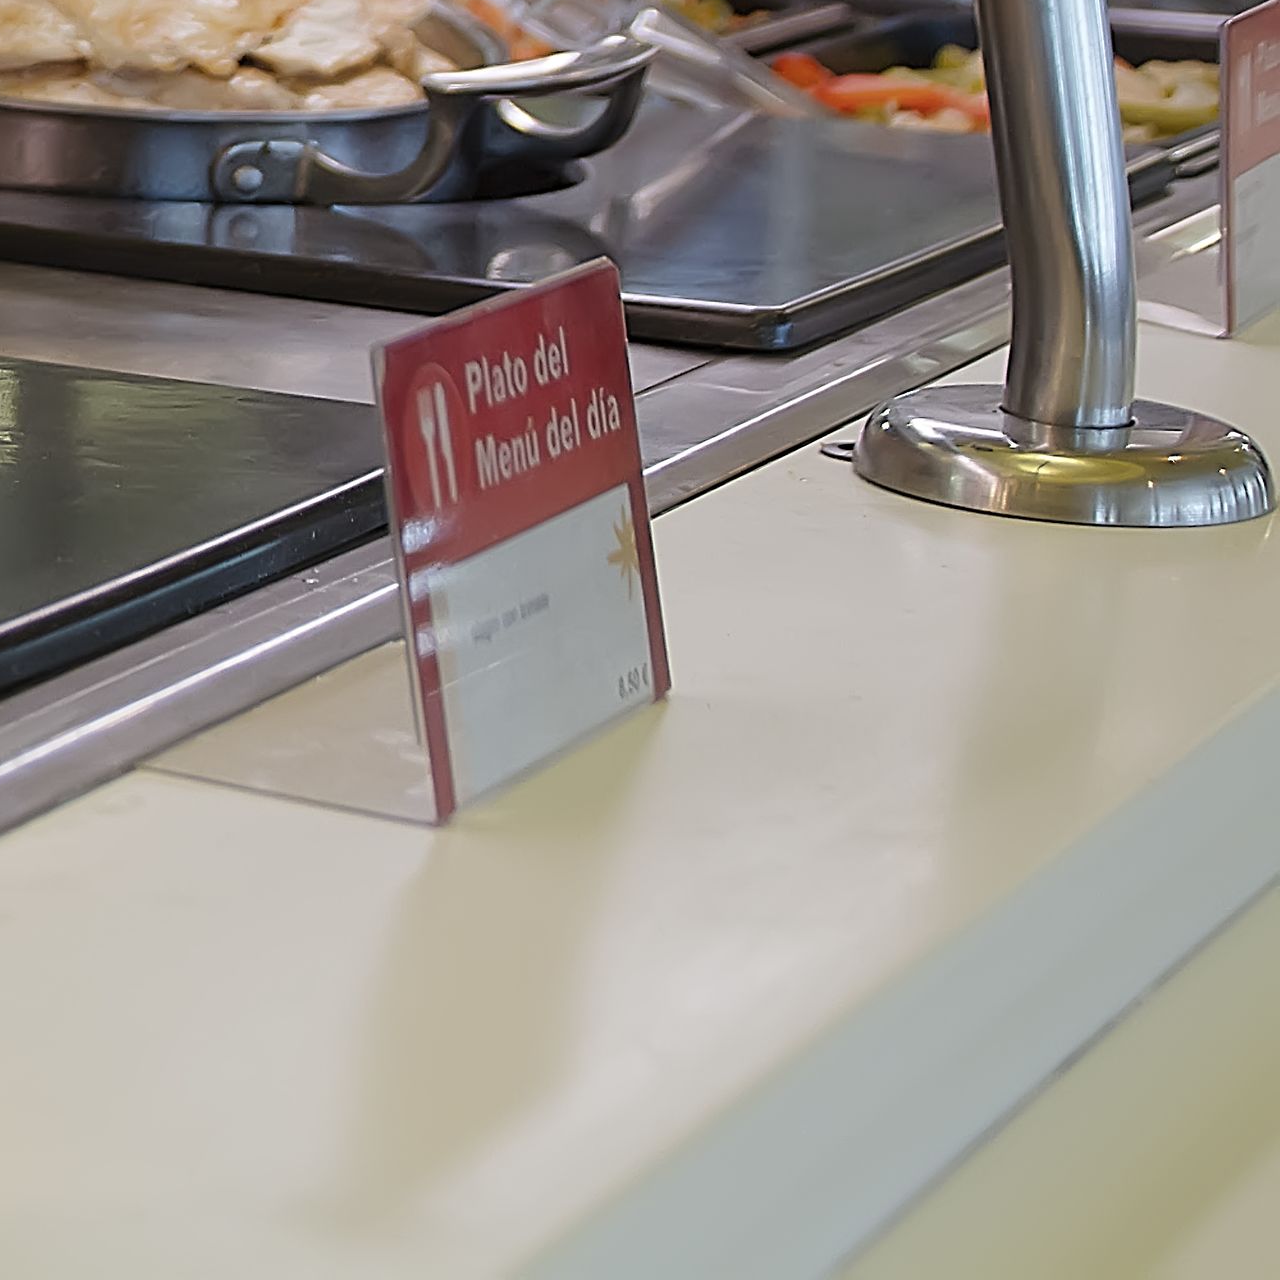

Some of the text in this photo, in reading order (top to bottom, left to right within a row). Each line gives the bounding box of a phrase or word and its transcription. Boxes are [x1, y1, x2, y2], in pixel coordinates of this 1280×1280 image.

[464, 325, 570, 415] Plato del
[474, 386, 622, 491] Menú del día
